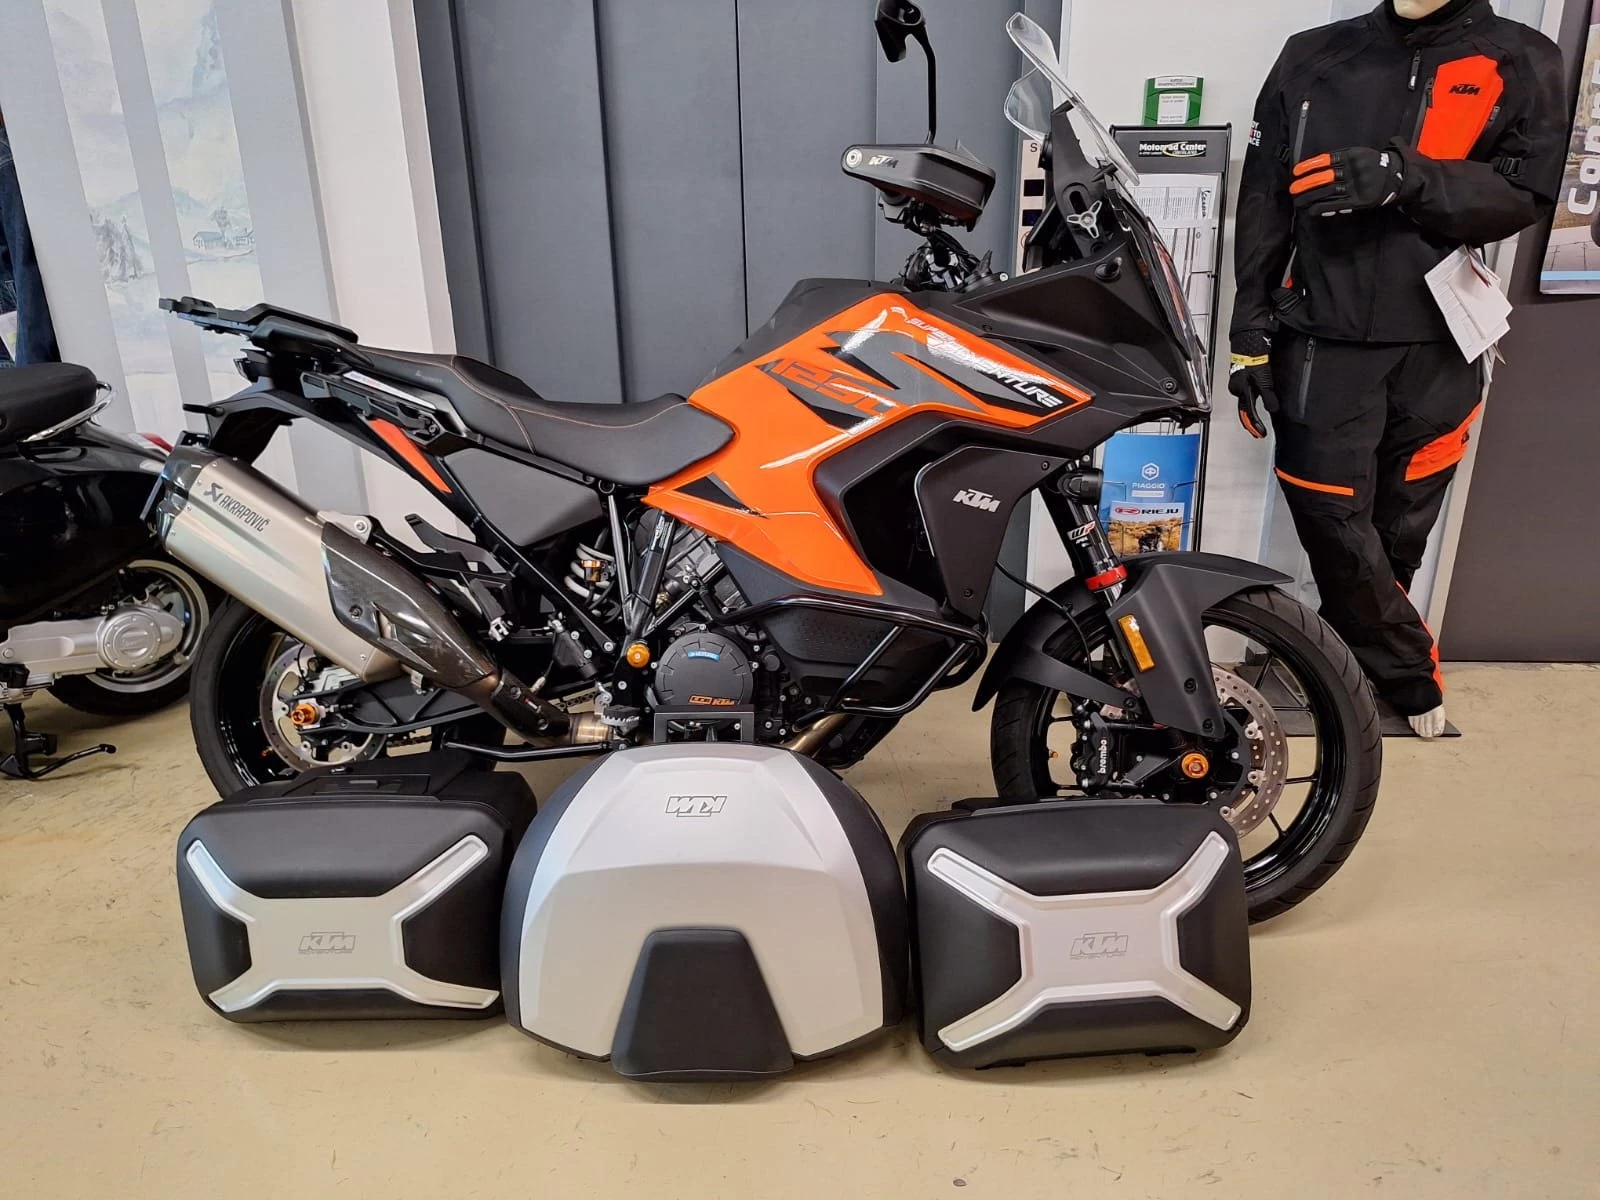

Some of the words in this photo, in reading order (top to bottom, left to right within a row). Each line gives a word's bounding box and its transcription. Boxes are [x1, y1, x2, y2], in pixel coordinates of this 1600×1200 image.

[1448, 83, 1481, 96] KTM
[868, 154, 899, 169] KTM
[952, 488, 1001, 513] KTM
[1096, 739, 1108, 774] brembo
[664, 795, 728, 818] KTM
[297, 931, 357, 951] KTM
[1070, 931, 1129, 956] KTM
